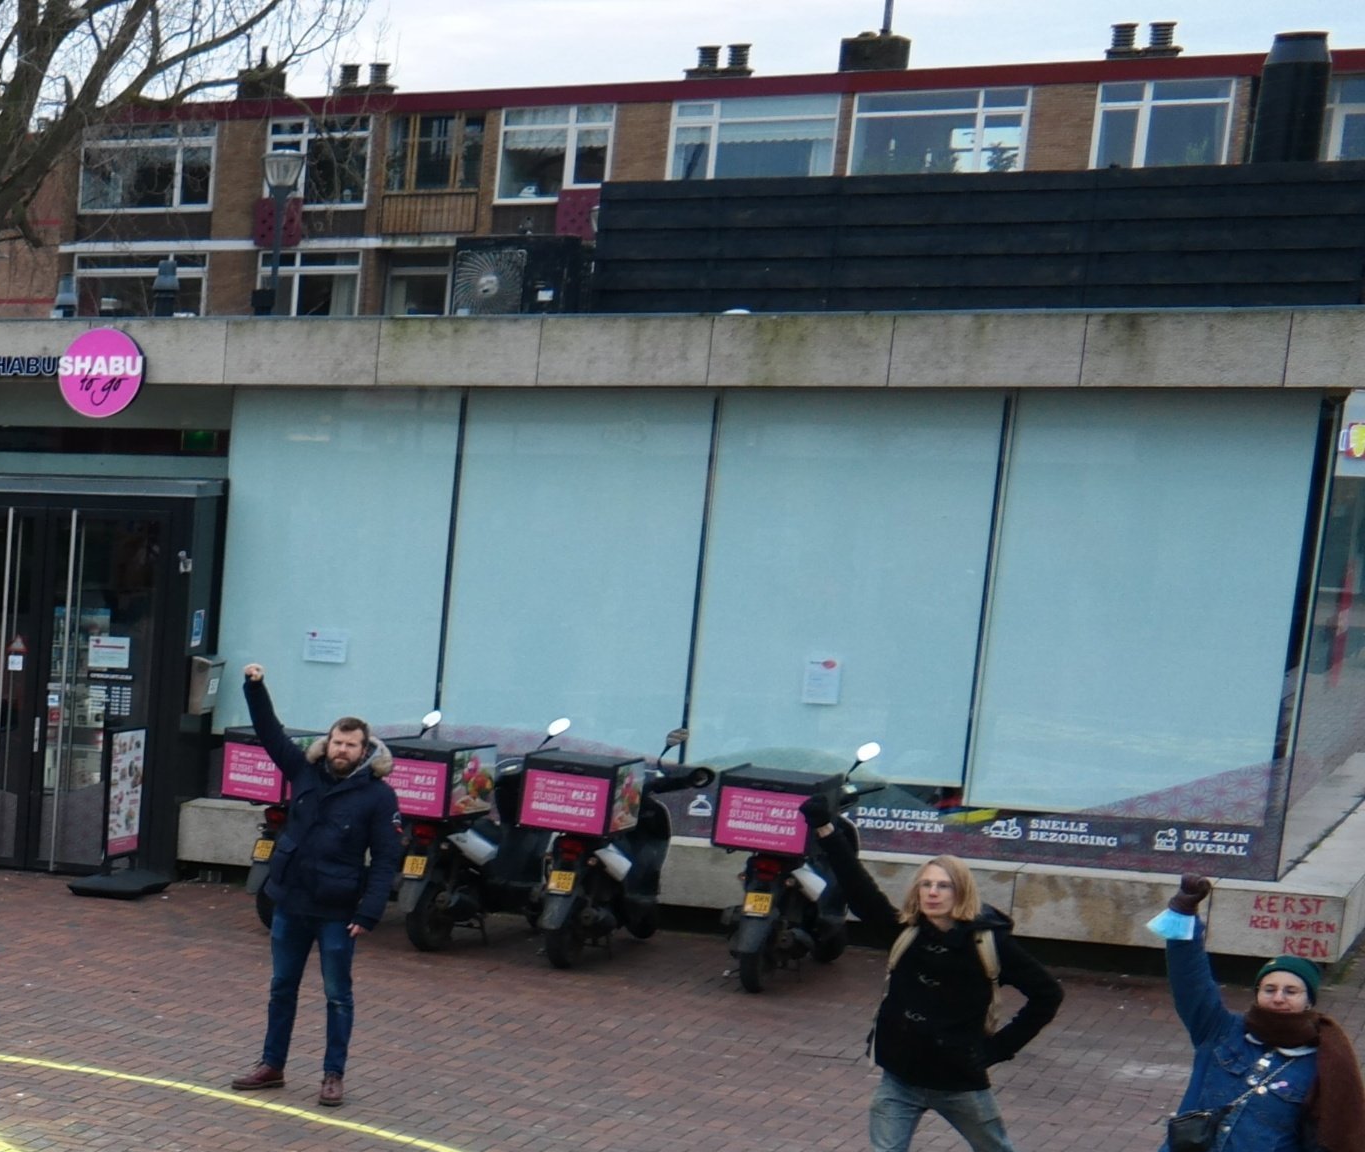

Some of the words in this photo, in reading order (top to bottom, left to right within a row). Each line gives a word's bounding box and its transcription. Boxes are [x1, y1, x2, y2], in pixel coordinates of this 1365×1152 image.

[79, 367, 101, 392] to
[90, 377, 129, 407] go
[856, 806, 888, 820] DAG
[891, 808, 939, 822] VERSE
[855, 817, 945, 834] PRODUCTEN
[1029, 818, 1089, 833] SNELLE
[1027, 830, 1118, 847] BEZORGING
[1183, 829, 1210, 842] WE
[1213, 831, 1251, 845] ZIJN
[1181, 841, 1248, 857] OVERAL
[1283, 936, 1329, 958] REN
